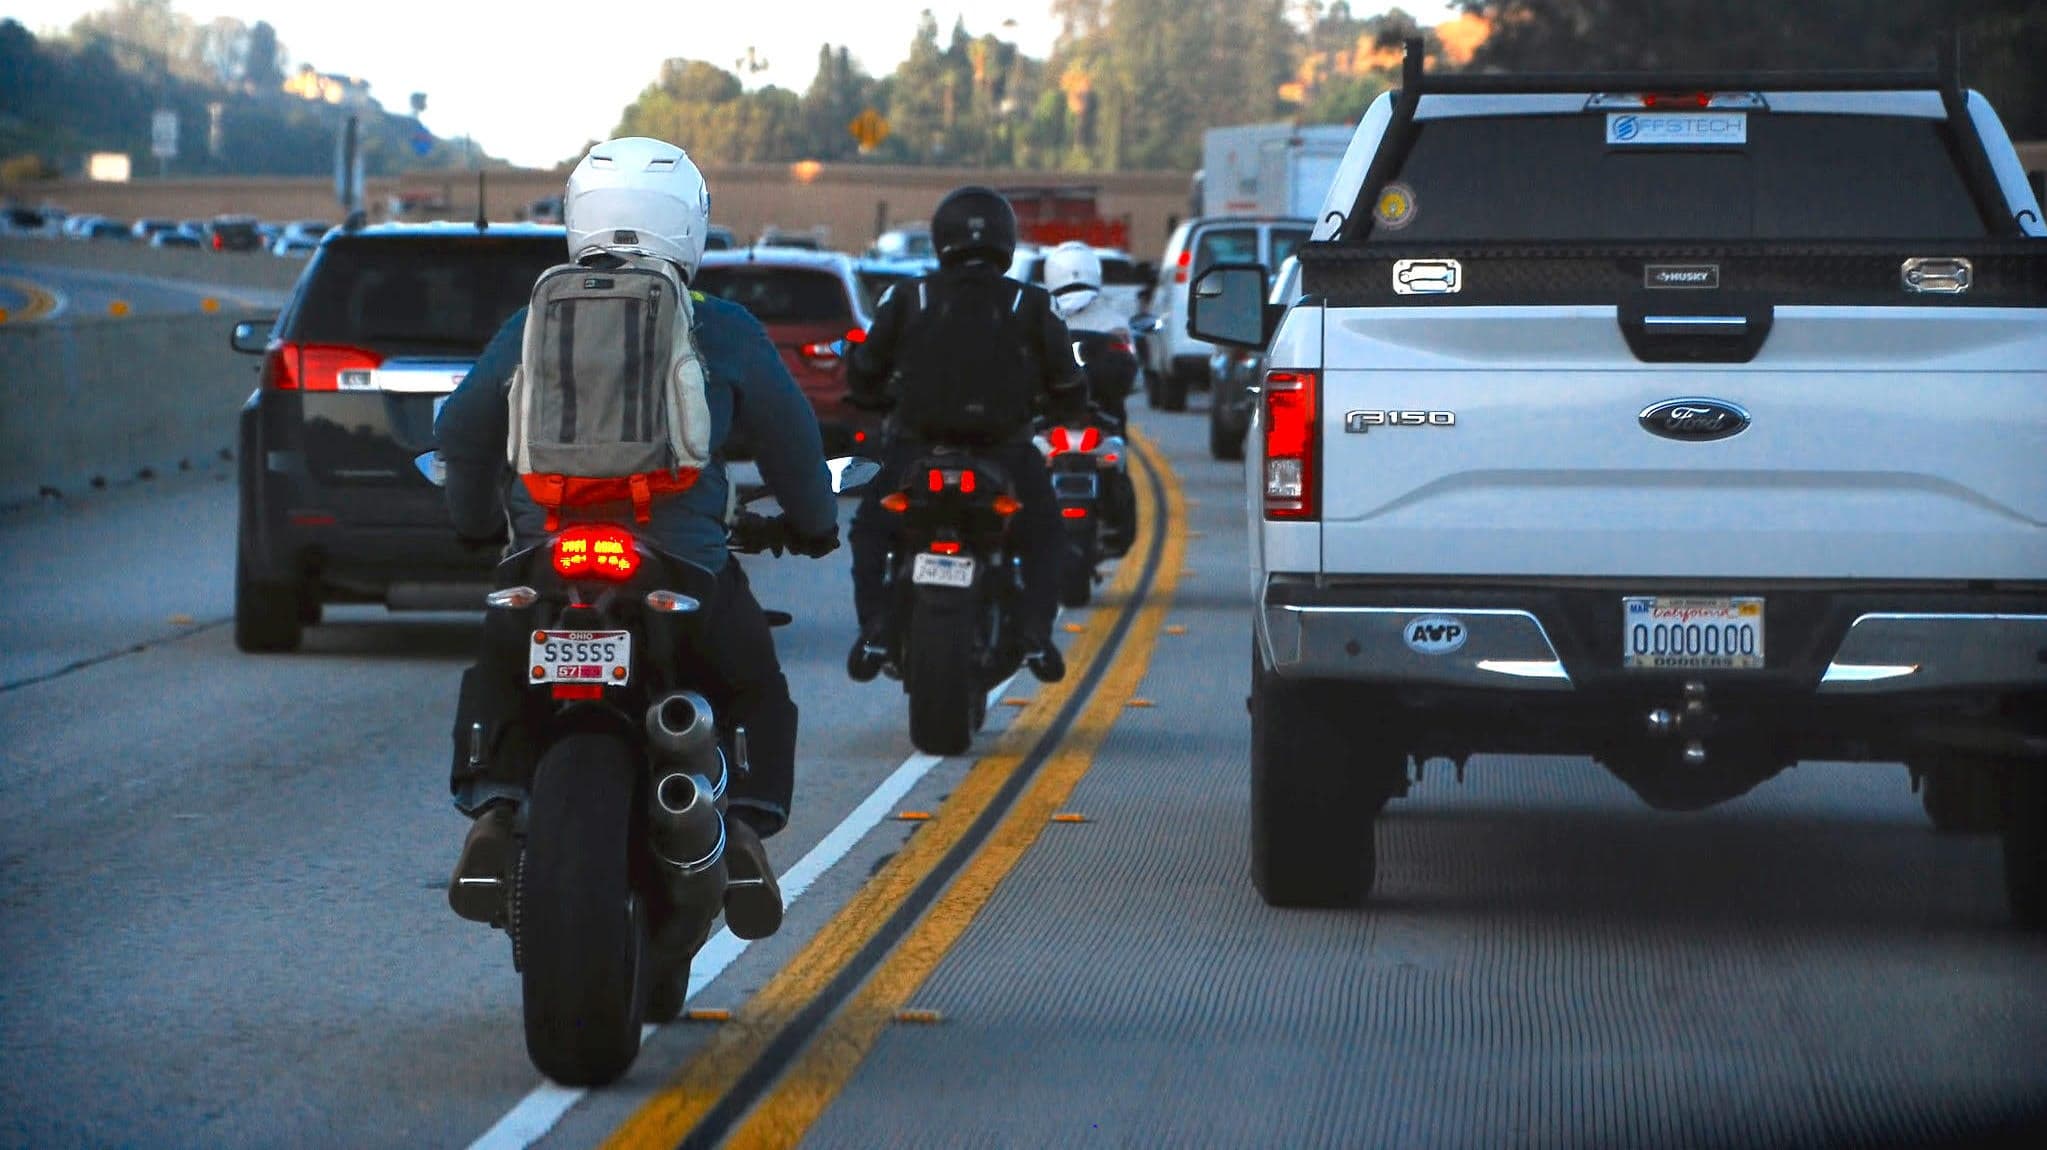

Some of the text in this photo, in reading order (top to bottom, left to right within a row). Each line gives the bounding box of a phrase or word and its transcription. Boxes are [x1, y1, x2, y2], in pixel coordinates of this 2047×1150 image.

[1670, 271, 1708, 281] HUSKY
[1663, 405, 1726, 434] Ford
[1629, 603, 1650, 614] MAR
[1653, 607, 1729, 622] California
[568, 632, 594, 641] OHIO
[544, 642, 617, 662] SSSSS
